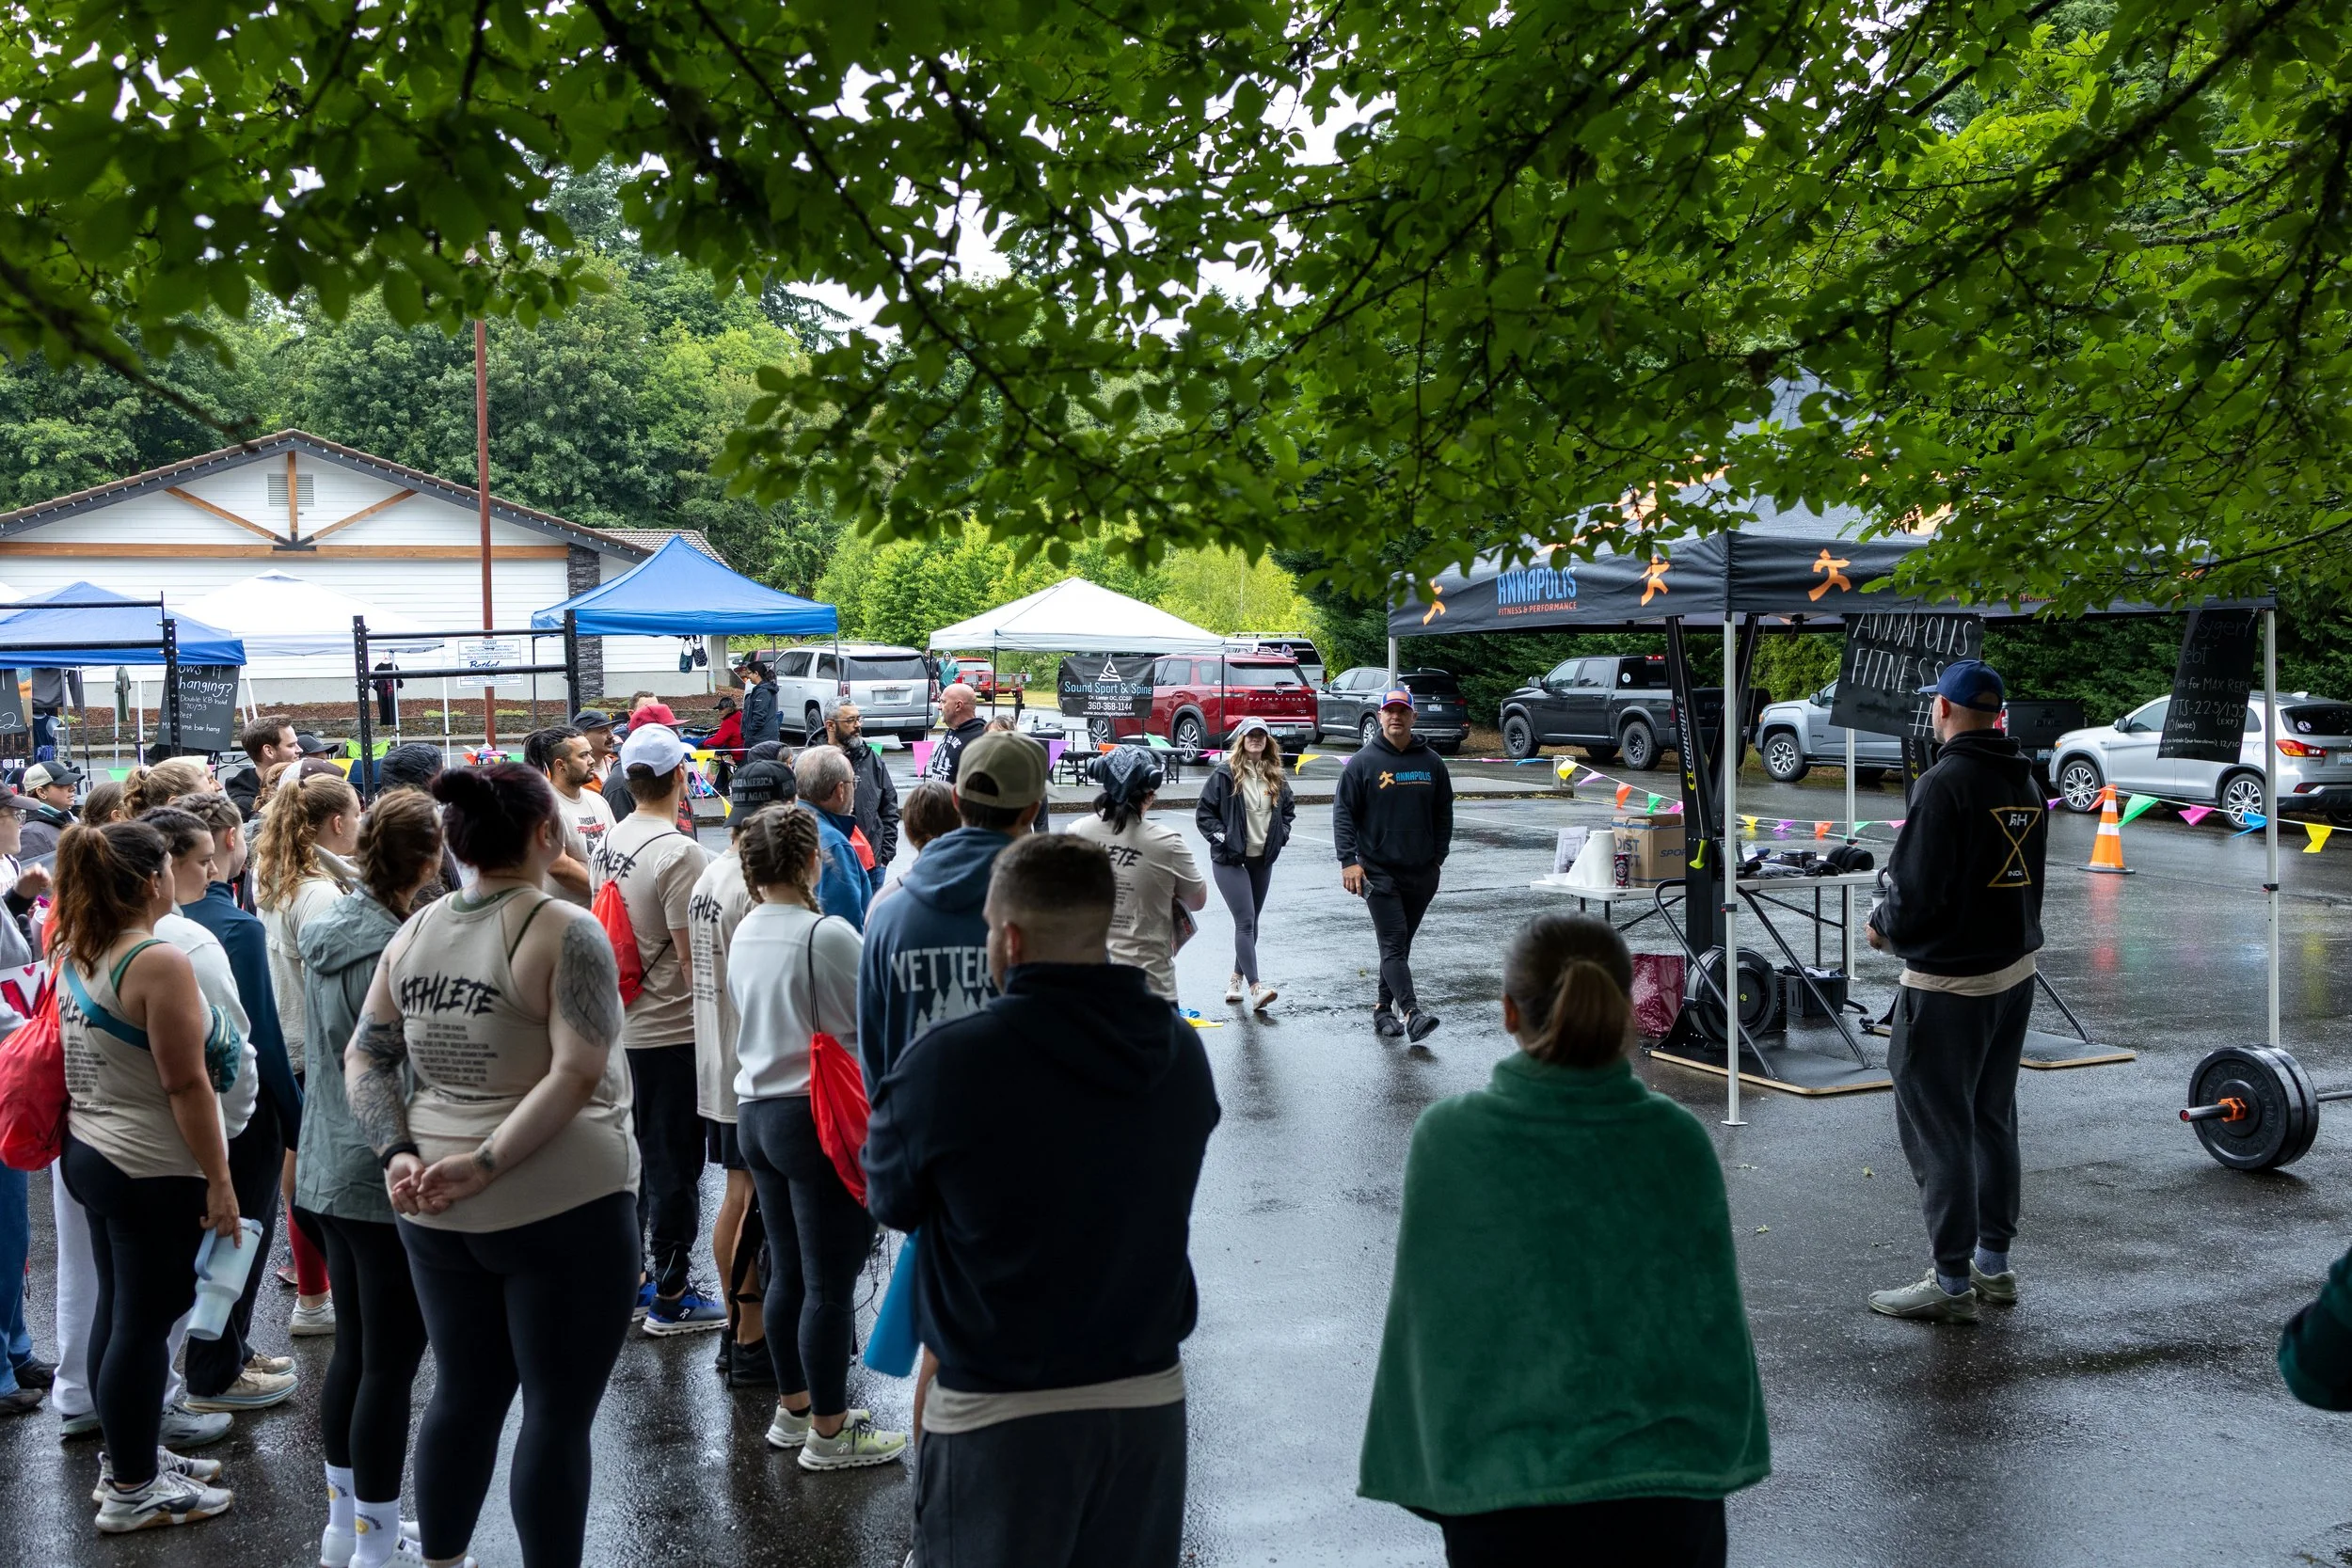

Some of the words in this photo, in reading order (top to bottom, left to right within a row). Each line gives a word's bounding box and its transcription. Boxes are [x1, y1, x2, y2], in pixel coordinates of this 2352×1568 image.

[1497, 566, 1577, 605] ANNAPOLIS
[1498, 607, 1522, 616] FITNESS
[1529, 601, 1577, 612] PERFORMANCE
[1852, 613, 1973, 657] ANNAPOLIS
[2185, 642, 2210, 665] ebt
[1851, 648, 1945, 699] FITNESS
[179, 676, 233, 697] hanging?
[1064, 681, 1092, 692] Sound
[1094, 682, 1118, 695] Sport
[1120, 683, 1129, 694] &
[1131, 684, 1152, 696] Spine
[2188, 676, 2201, 690] for
[2202, 677, 2225, 691] MAX
[2227, 678, 2251, 695] REPS
[180, 694, 201, 703] Double
[1677, 695, 1683, 705] 2
[184, 703, 207, 711] 70/53
[1088, 702, 1133, 711] 360-368-1144
[194, 723, 205, 732] bar
[206, 723, 220, 734] hang
[1677, 706, 1692, 769] concept
[2219, 739, 2240, 748] 12/10
[1395, 770, 1432, 782] ANNAPOLIS
[401, 969, 501, 1018] ATHLETE
